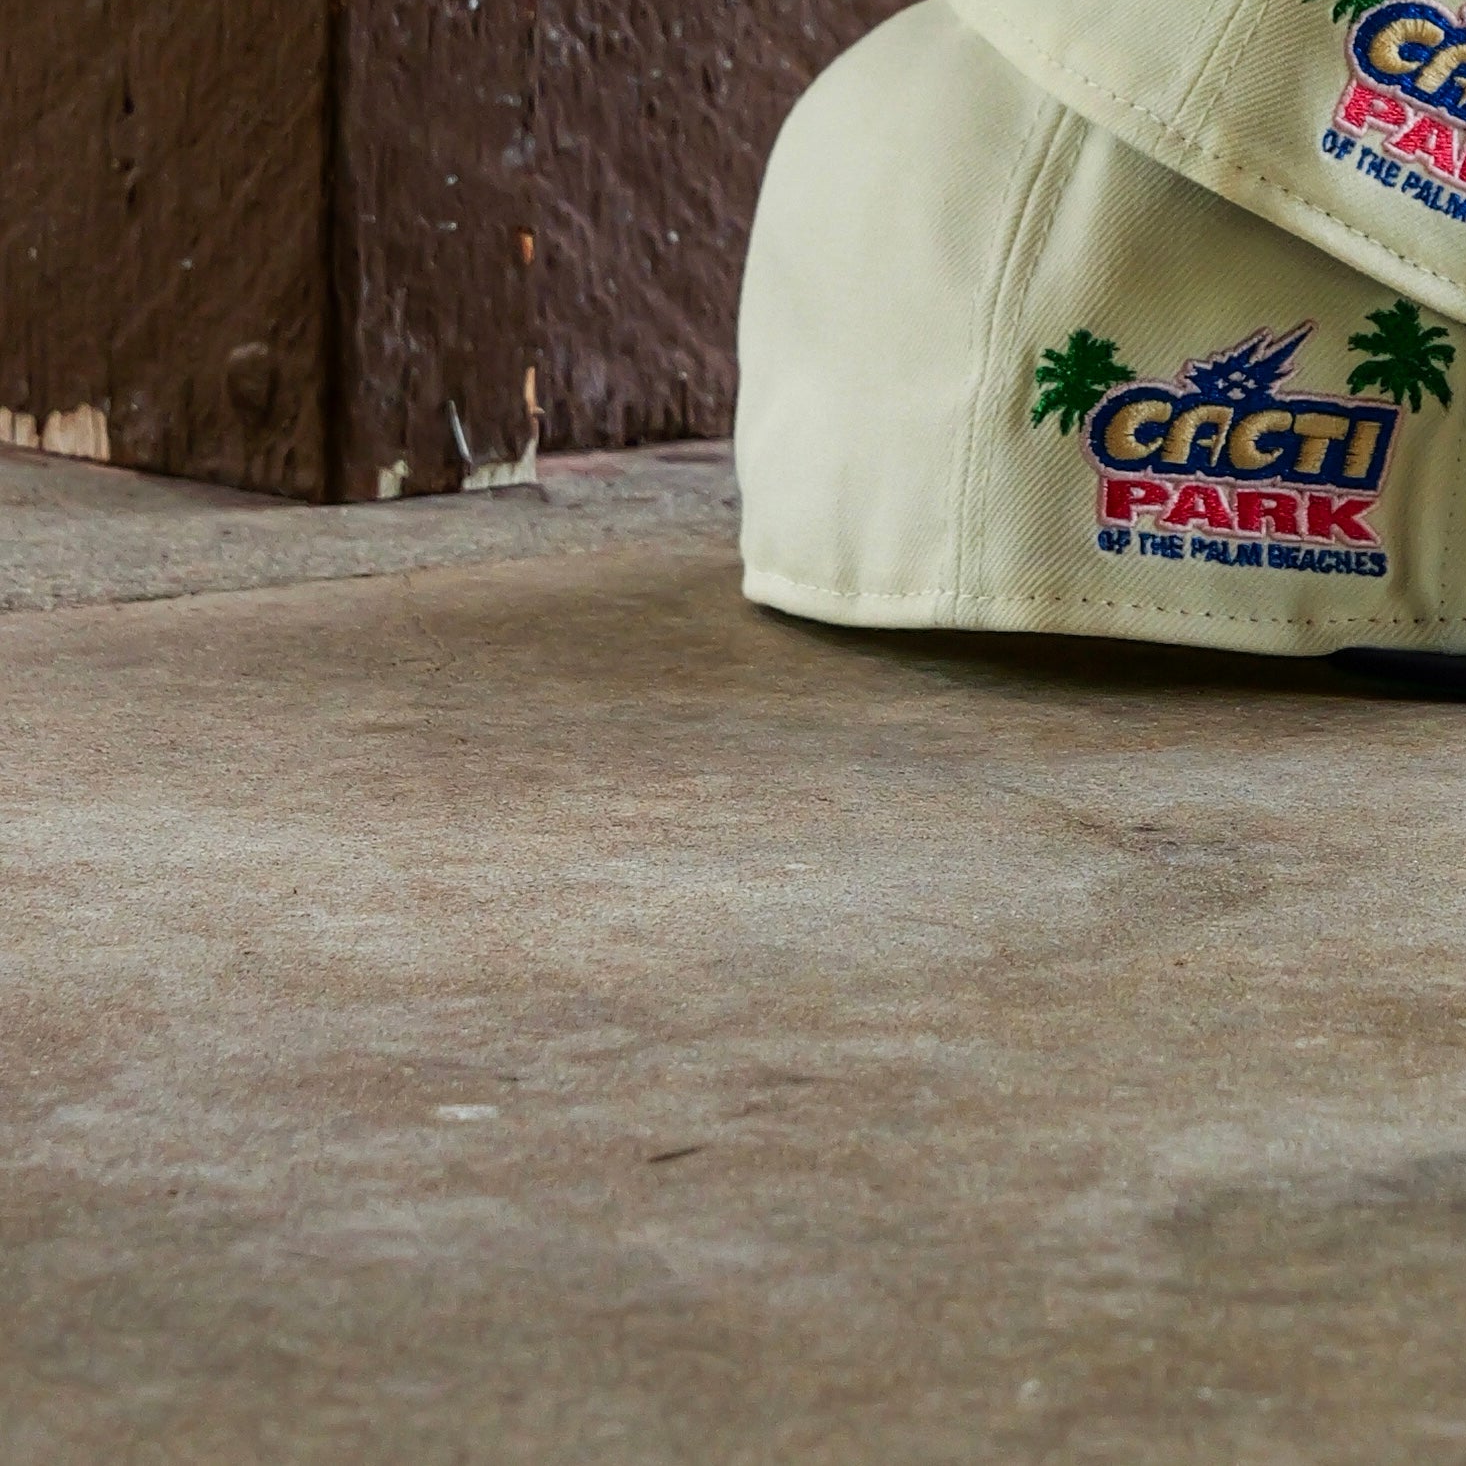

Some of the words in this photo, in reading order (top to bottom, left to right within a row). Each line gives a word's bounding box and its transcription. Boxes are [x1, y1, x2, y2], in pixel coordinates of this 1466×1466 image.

[1322, 127, 1357, 161] OF
[1356, 144, 1402, 188] THE
[1104, 399, 1383, 479] CACTI
[1104, 478, 1378, 543] PARK
[1097, 528, 1131, 554] OF
[1138, 532, 1184, 559] THE
[1190, 536, 1264, 568] PALM
[1267, 543, 1388, 577] BEACHES
